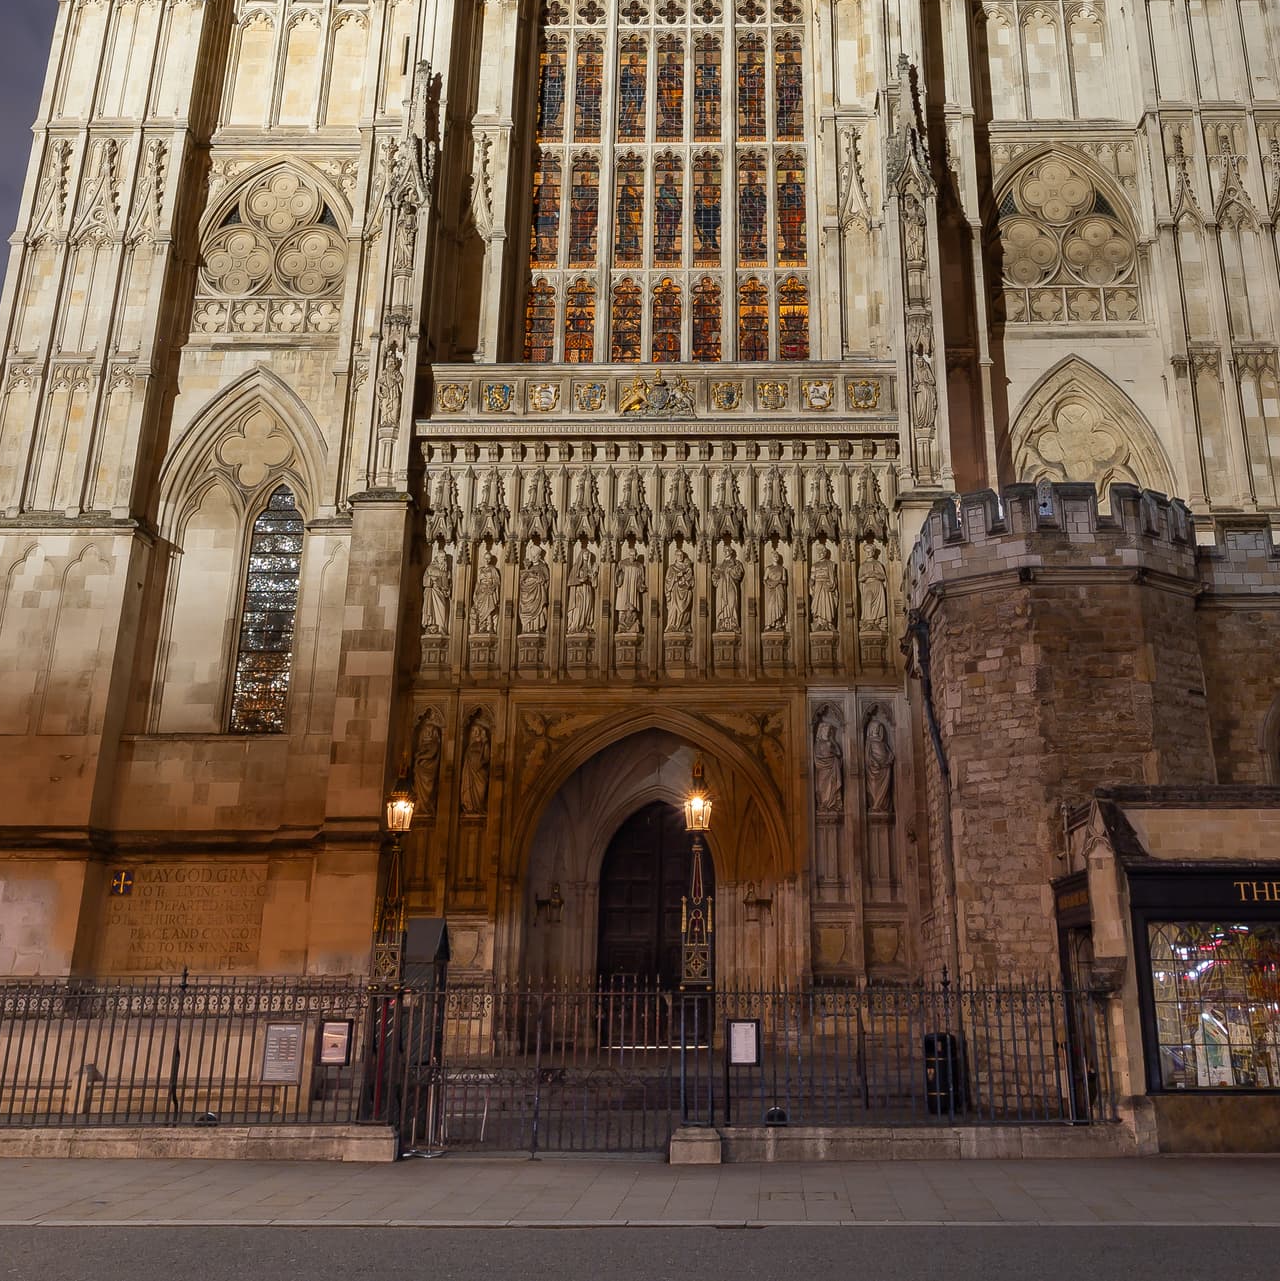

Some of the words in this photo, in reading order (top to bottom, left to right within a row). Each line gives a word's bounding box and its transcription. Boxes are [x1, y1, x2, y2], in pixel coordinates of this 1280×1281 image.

[175, 869, 213, 883] GOD
[216, 868, 268, 883] GRAN
[130, 928, 169, 939] PEACE
[173, 928, 199, 939] AND
[202, 928, 260, 939] CONCOR
[128, 942, 155, 953] AND
[159, 942, 174, 952] TO
[178, 942, 194, 952] US
[197, 942, 250, 952] SINNERS
